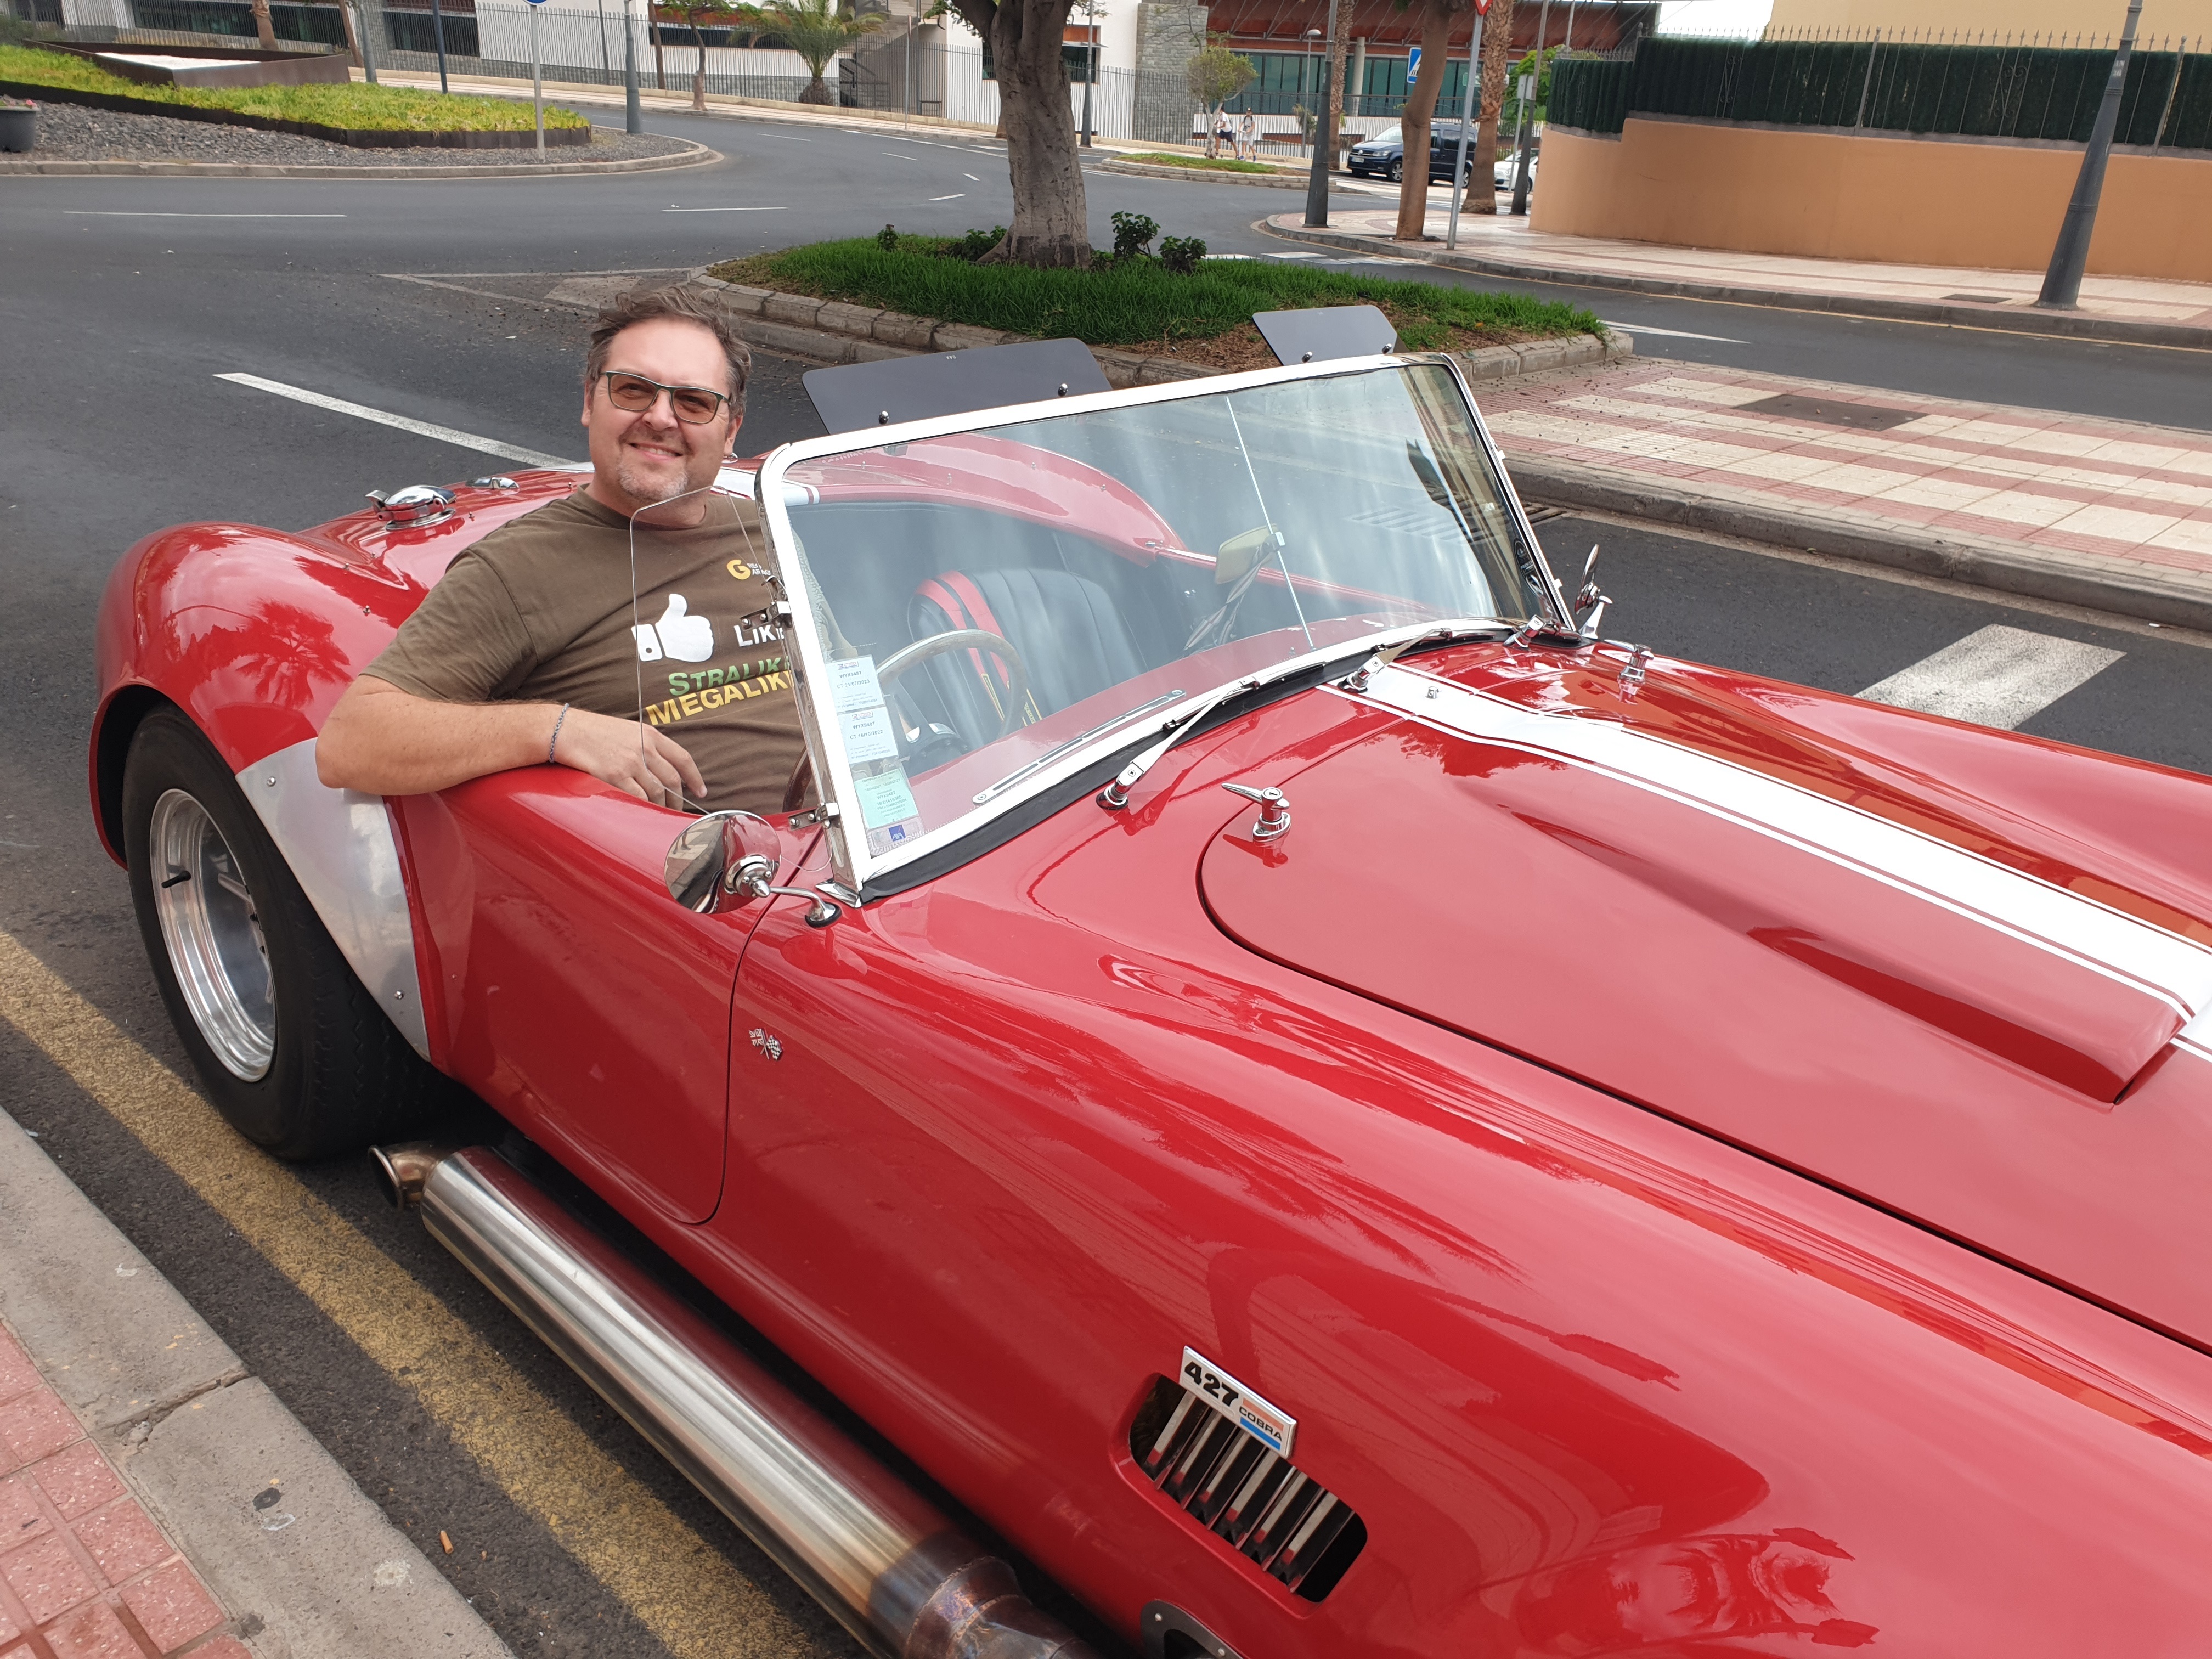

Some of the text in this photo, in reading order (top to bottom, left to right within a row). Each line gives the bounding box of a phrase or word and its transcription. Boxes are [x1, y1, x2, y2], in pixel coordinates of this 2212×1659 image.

[858, 730, 883, 738] 16/10/2022
[1184, 1361, 1283, 1442] 427 COBRA
